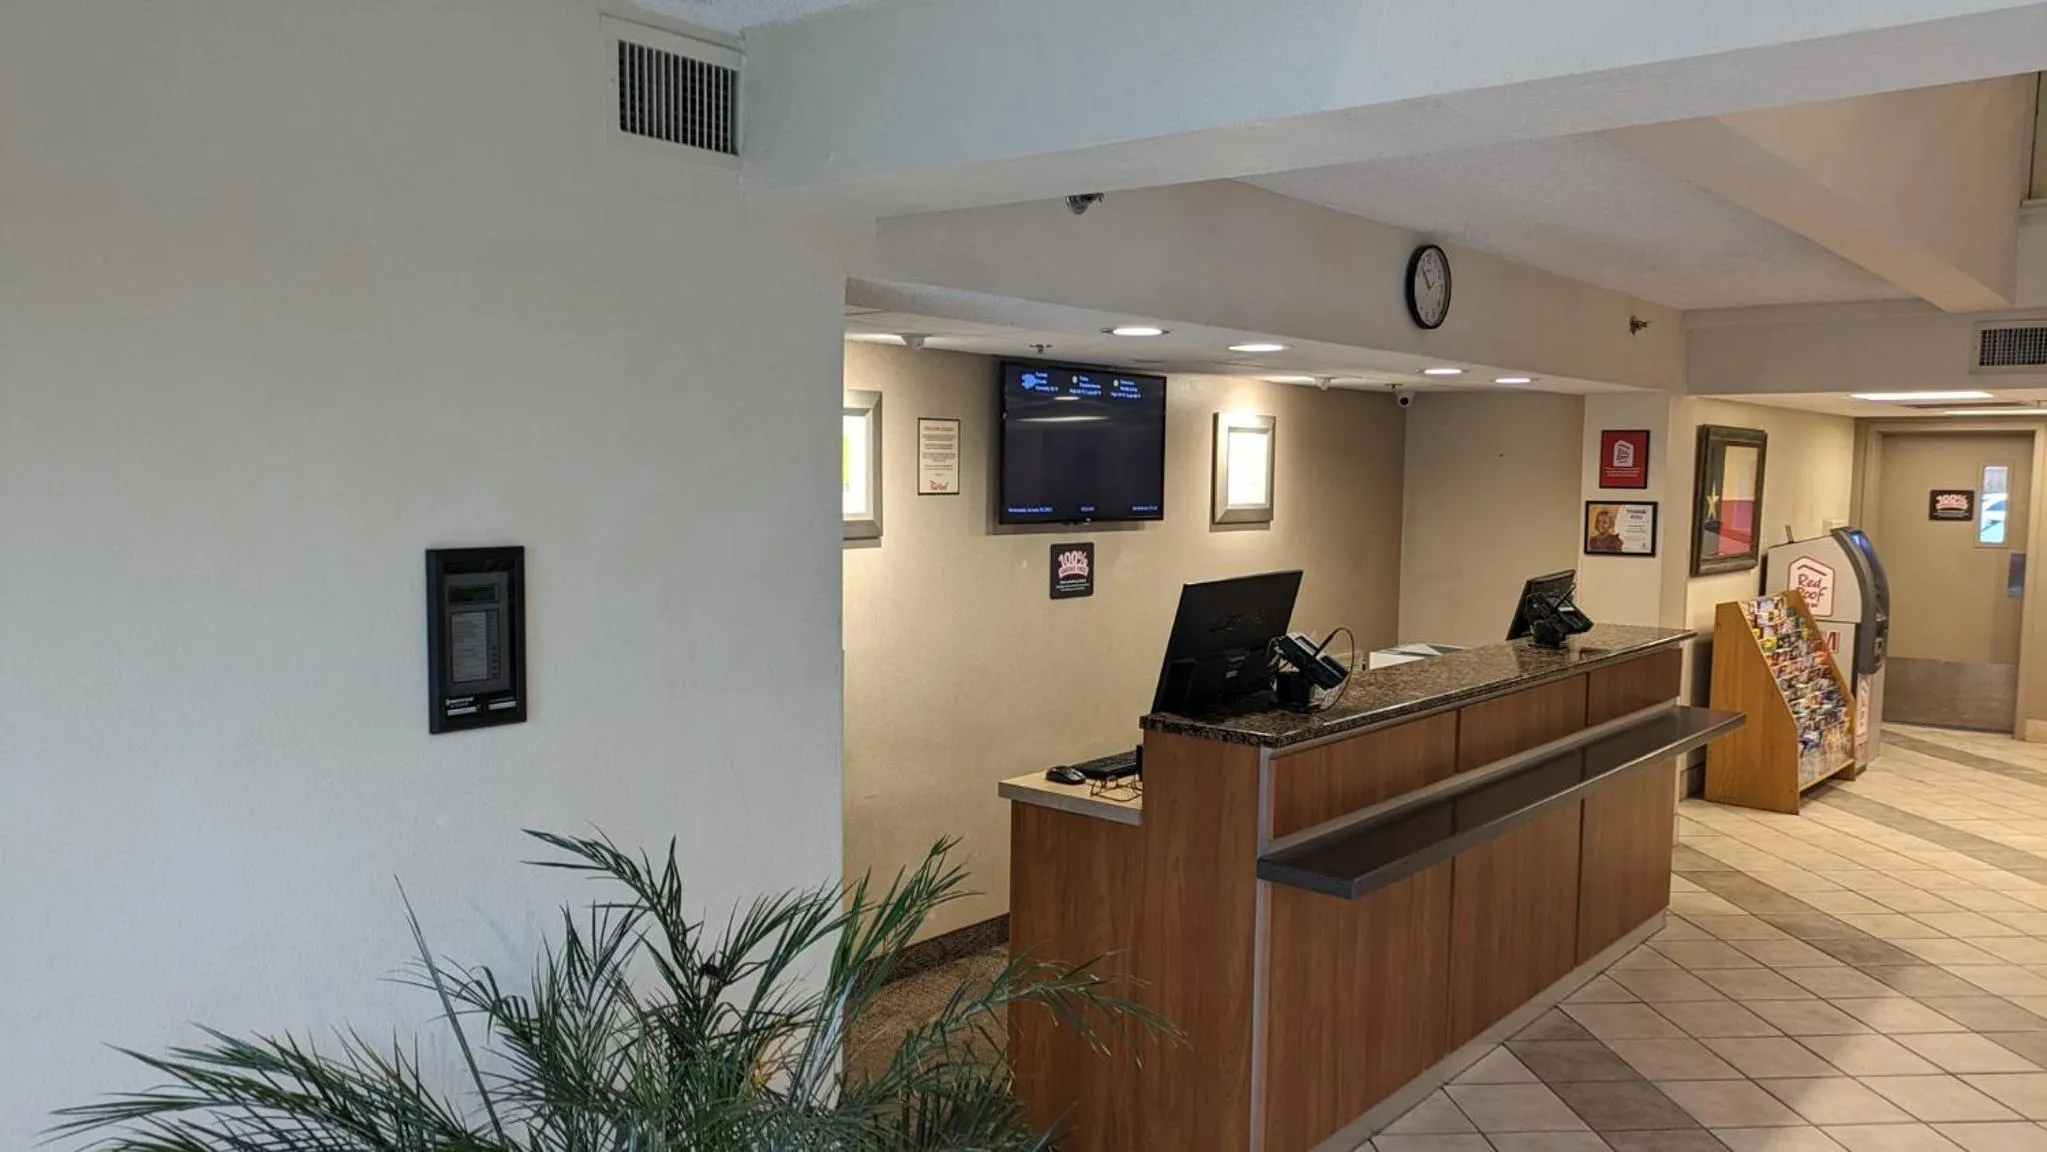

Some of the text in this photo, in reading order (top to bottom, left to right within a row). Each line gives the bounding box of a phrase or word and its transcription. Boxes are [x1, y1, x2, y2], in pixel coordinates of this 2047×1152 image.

[1936, 494, 1968, 505] 100%
[1058, 550, 1088, 568] 100%
[1798, 573, 1822, 588] Red
